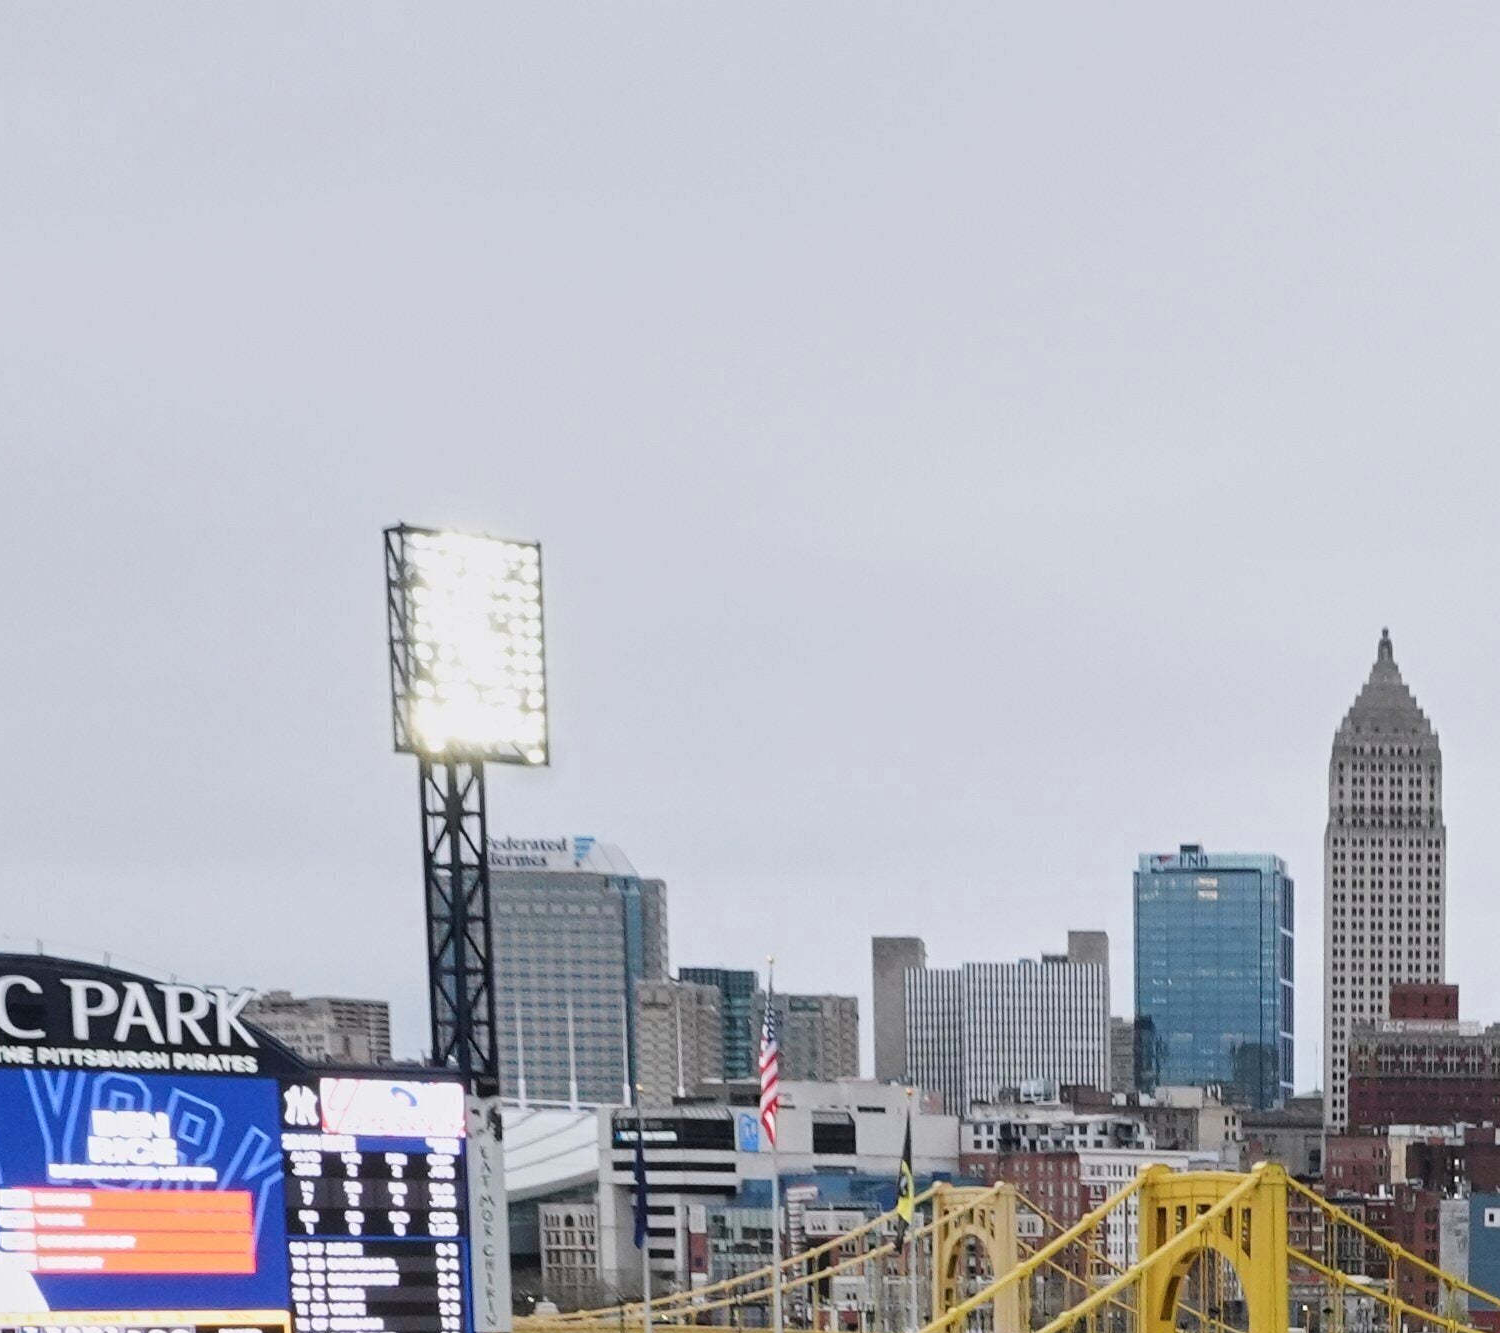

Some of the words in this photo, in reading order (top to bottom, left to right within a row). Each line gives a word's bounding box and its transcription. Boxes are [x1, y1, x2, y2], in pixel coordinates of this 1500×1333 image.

[59, 976, 261, 1049] PARK
[36, 1047, 171, 1070] PITTSBURGH
[171, 1052, 260, 1075] PIRATES
[90, 1109, 171, 1139] BEN
